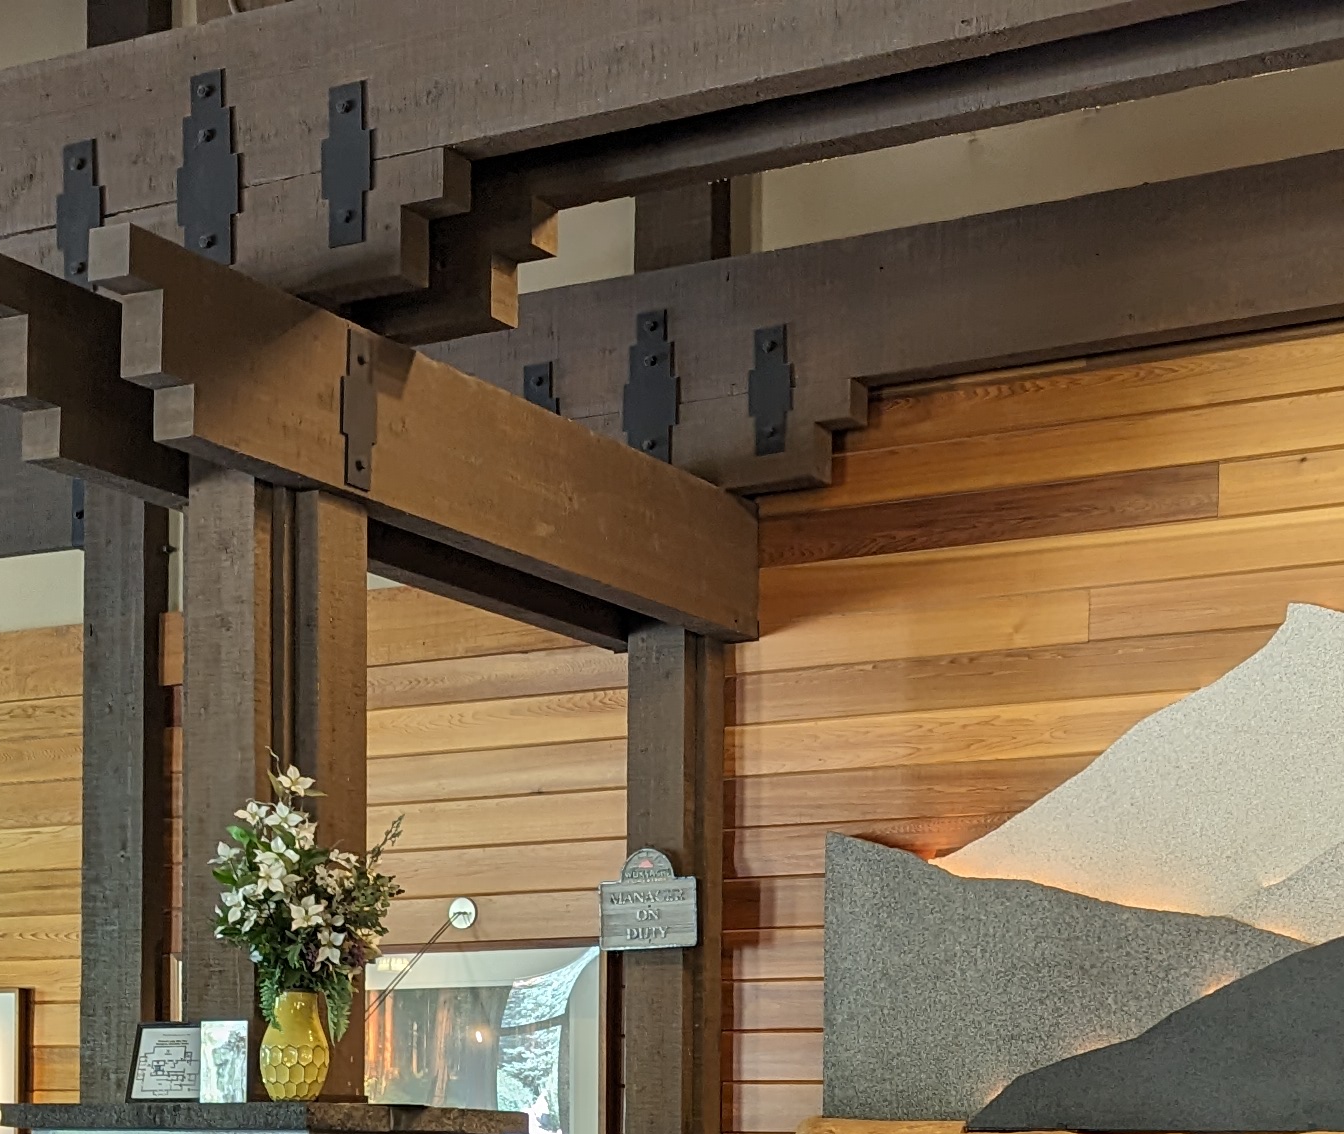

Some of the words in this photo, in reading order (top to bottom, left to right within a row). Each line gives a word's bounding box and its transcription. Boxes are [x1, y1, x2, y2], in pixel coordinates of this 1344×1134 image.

[610, 888, 686, 905] MANAGER
[636, 909, 660, 922] ON
[626, 926, 671, 940] DUTY
